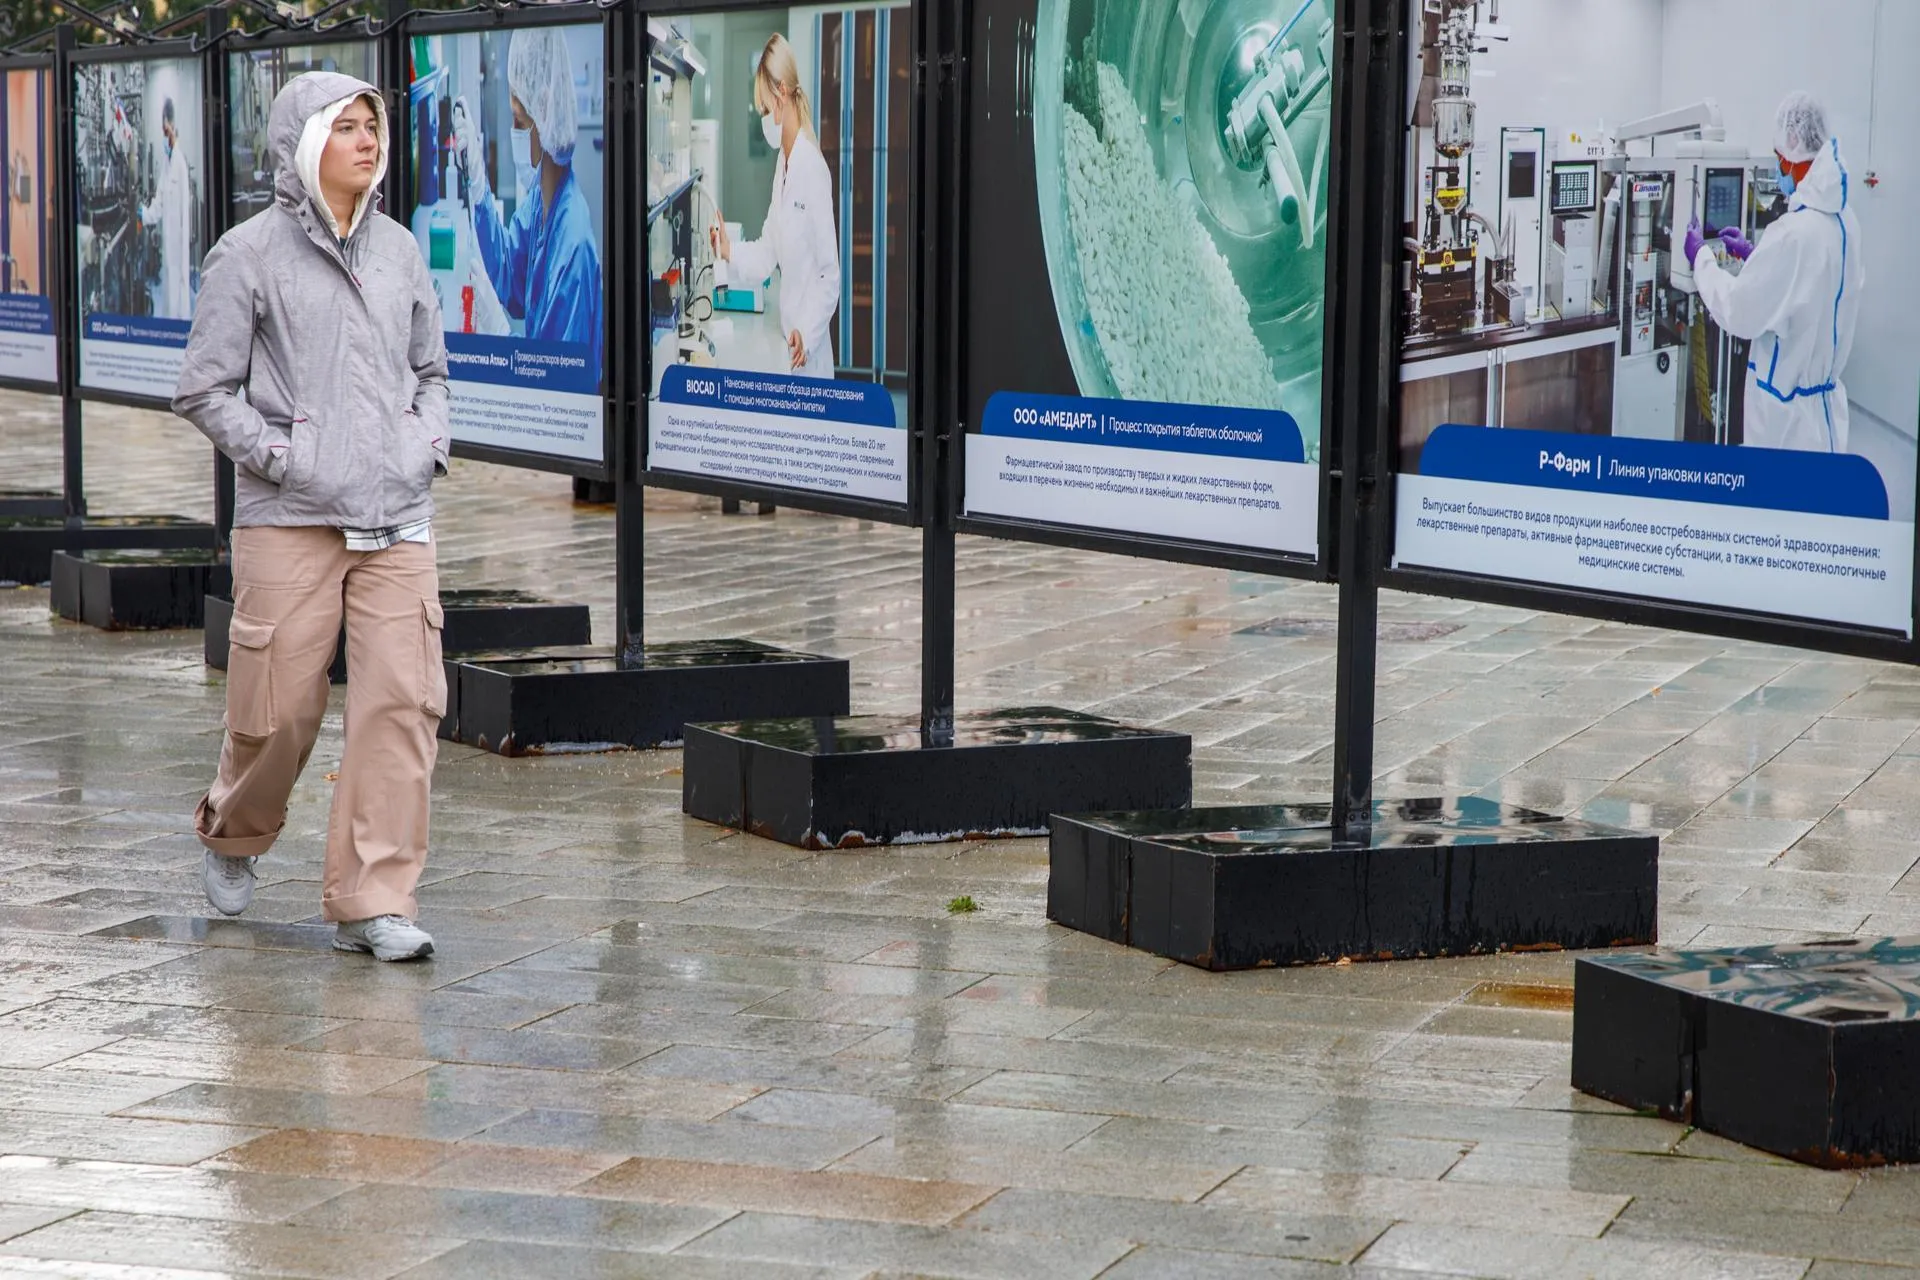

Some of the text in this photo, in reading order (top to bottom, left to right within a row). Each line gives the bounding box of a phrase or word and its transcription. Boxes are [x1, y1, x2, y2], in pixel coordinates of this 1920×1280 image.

[687, 380, 715, 395] BIOCAD
[724, 378, 864, 401] Нанесение на планшет образца для исследования
[728, 394, 754, 405] помощью
[755, 397, 800, 410] многоканальной
[802, 402, 825, 413] пипетки
[1014, 408, 1262, 442] ООО «АМЕДАРТ» Процесс покрытия таблеток оболочкой
[868, 440, 876, 449] 20
[1006, 456, 1064, 470] Фармацевтический
[1065, 463, 1082, 474] завод
[1084, 465, 1092, 473] по
[1093, 466, 1136, 480] производству
[1138, 471, 1165, 482] твердых
[1172, 474, 1197, 484] жидких
[1199, 477, 1252, 489] лекарственных
[1253, 480, 1274, 494] форм,
[1540, 452, 1745, 491] Р-Фарм Линия упаковки капсул
[999, 472, 1028, 483] входящих
[1034, 476, 1062, 486] перечень
[1064, 479, 1094, 489] жизненно
[1095, 482, 1138, 494] необходимых
[1145, 488, 1183, 499] важнейших
[1185, 492, 1236, 505] лекарственных
[1238, 498, 1282, 510] препаратов.
[1422, 498, 1881, 557] Выпускает большинство видов продукции наиболее востребованных системой здравоохранения:
[1416, 518, 1479, 533] лекарственные
[1480, 525, 1529, 541] препараты,
[1531, 531, 1572, 544] активные
[1575, 533, 1662, 554] фармацевтические
[1665, 544, 1724, 563] субстанции,
[1735, 554, 1763, 566] также
[1766, 558, 1886, 580] высокотехнологичные
[1578, 556, 1685, 575] медицинские системы.
